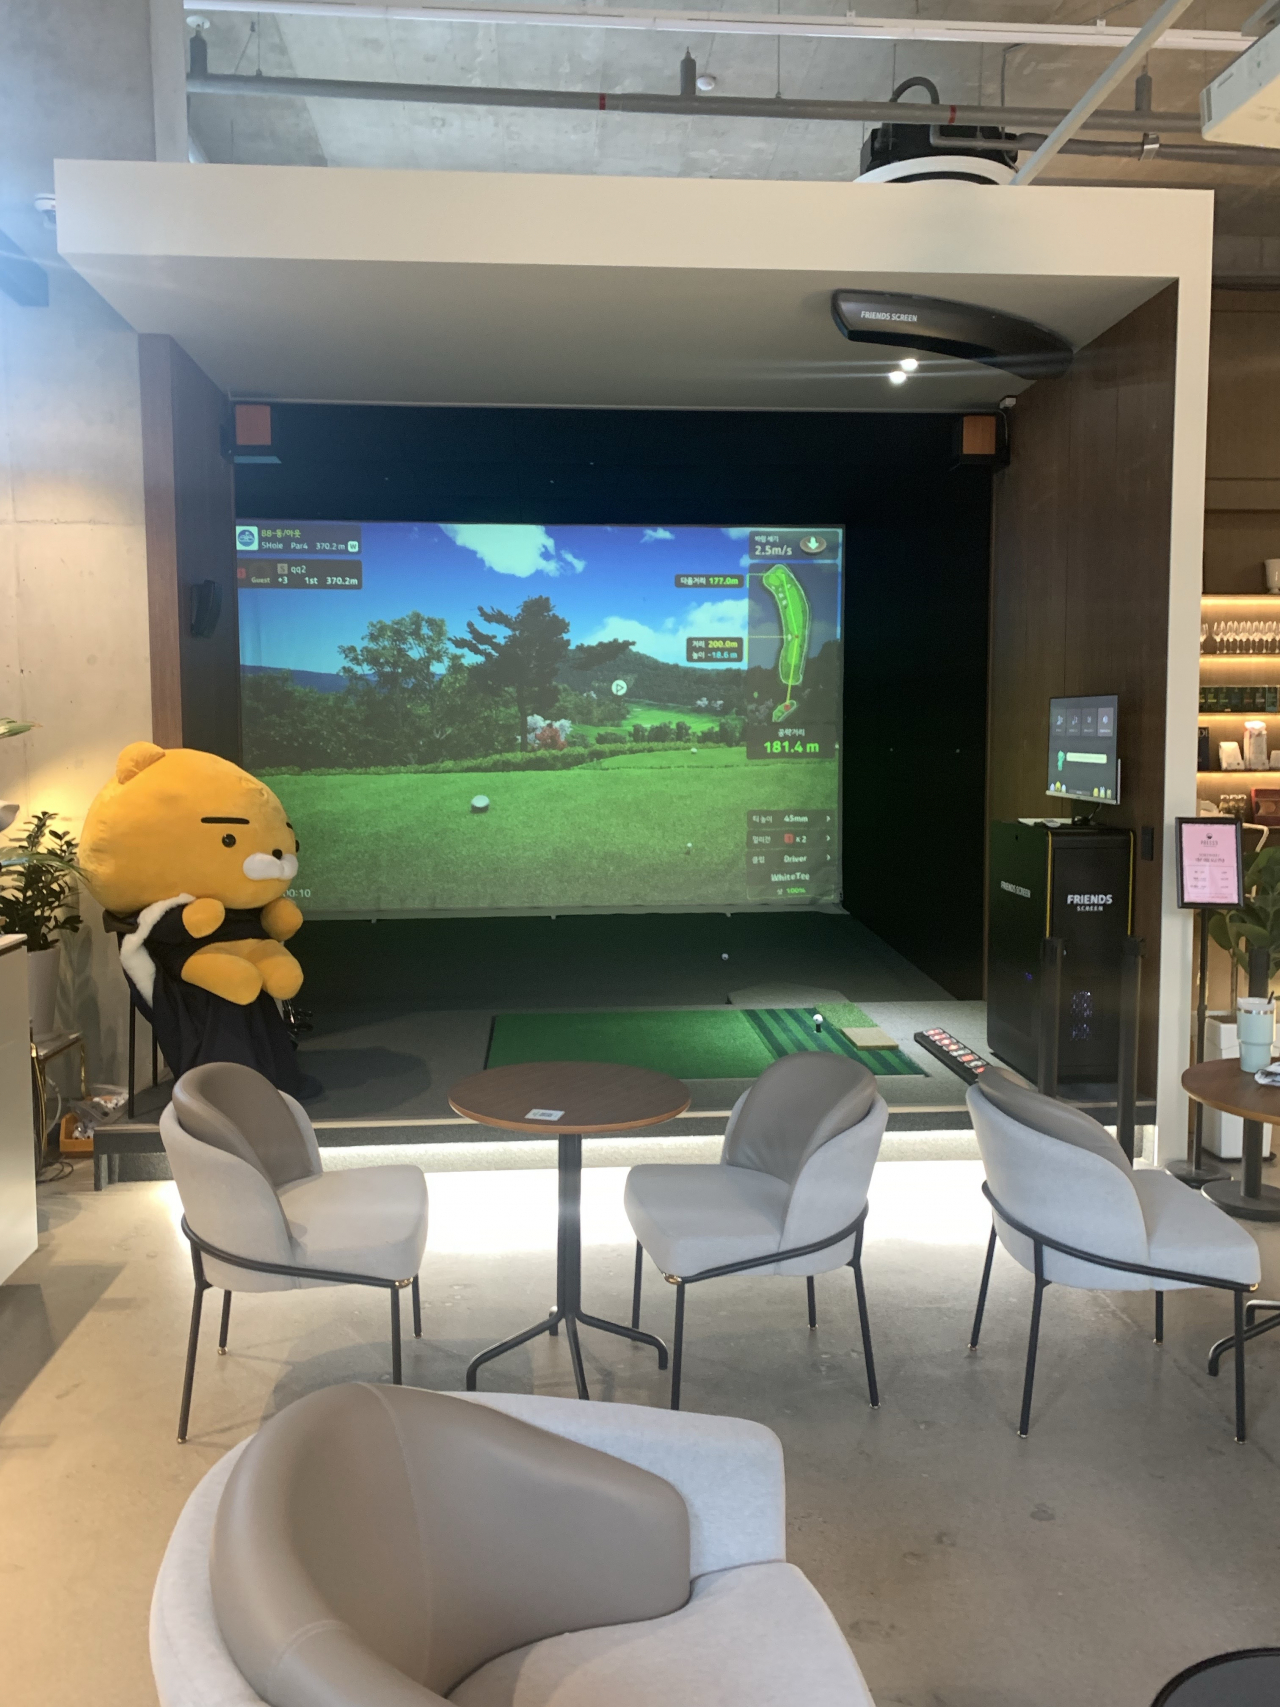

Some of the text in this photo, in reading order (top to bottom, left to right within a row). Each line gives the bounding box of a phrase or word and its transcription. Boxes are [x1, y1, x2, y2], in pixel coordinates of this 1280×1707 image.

[860, 310, 918, 322] FRIENDS SCREEN
[261, 541, 284, 550] 5Hole
[290, 541, 309, 550] Par4
[754, 545, 793, 556] 2.5m/s
[251, 576, 271, 584] Guest
[304, 576, 318, 585] 1st
[326, 576, 359, 585] 370.2m
[708, 576, 739, 585] 177.0m
[691, 640, 739, 648] 거리 200.0m
[783, 814, 809, 823] 45mm
[783, 854, 807, 863] Driver
[1000, 880, 1031, 898] FRIENDS SCREEN
[1066, 894, 1113, 905] FRIENDS
